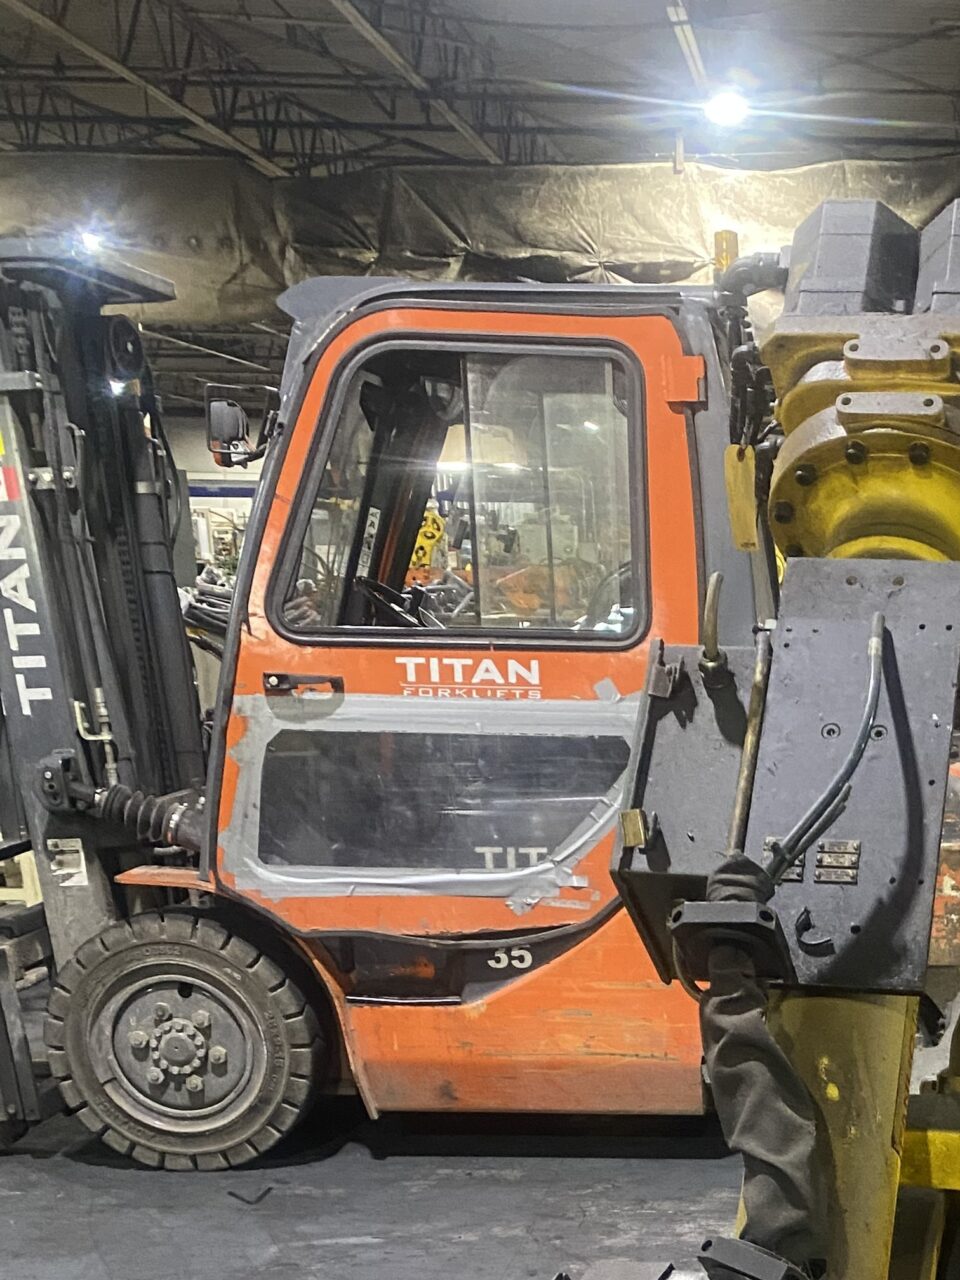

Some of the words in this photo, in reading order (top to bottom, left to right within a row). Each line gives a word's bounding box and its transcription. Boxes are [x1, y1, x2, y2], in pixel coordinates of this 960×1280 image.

[0, 514, 53, 717] TITAN
[395, 656, 540, 685] TITAN
[403, 687, 541, 699] FORKLIFTS
[487, 946, 533, 969] 35
